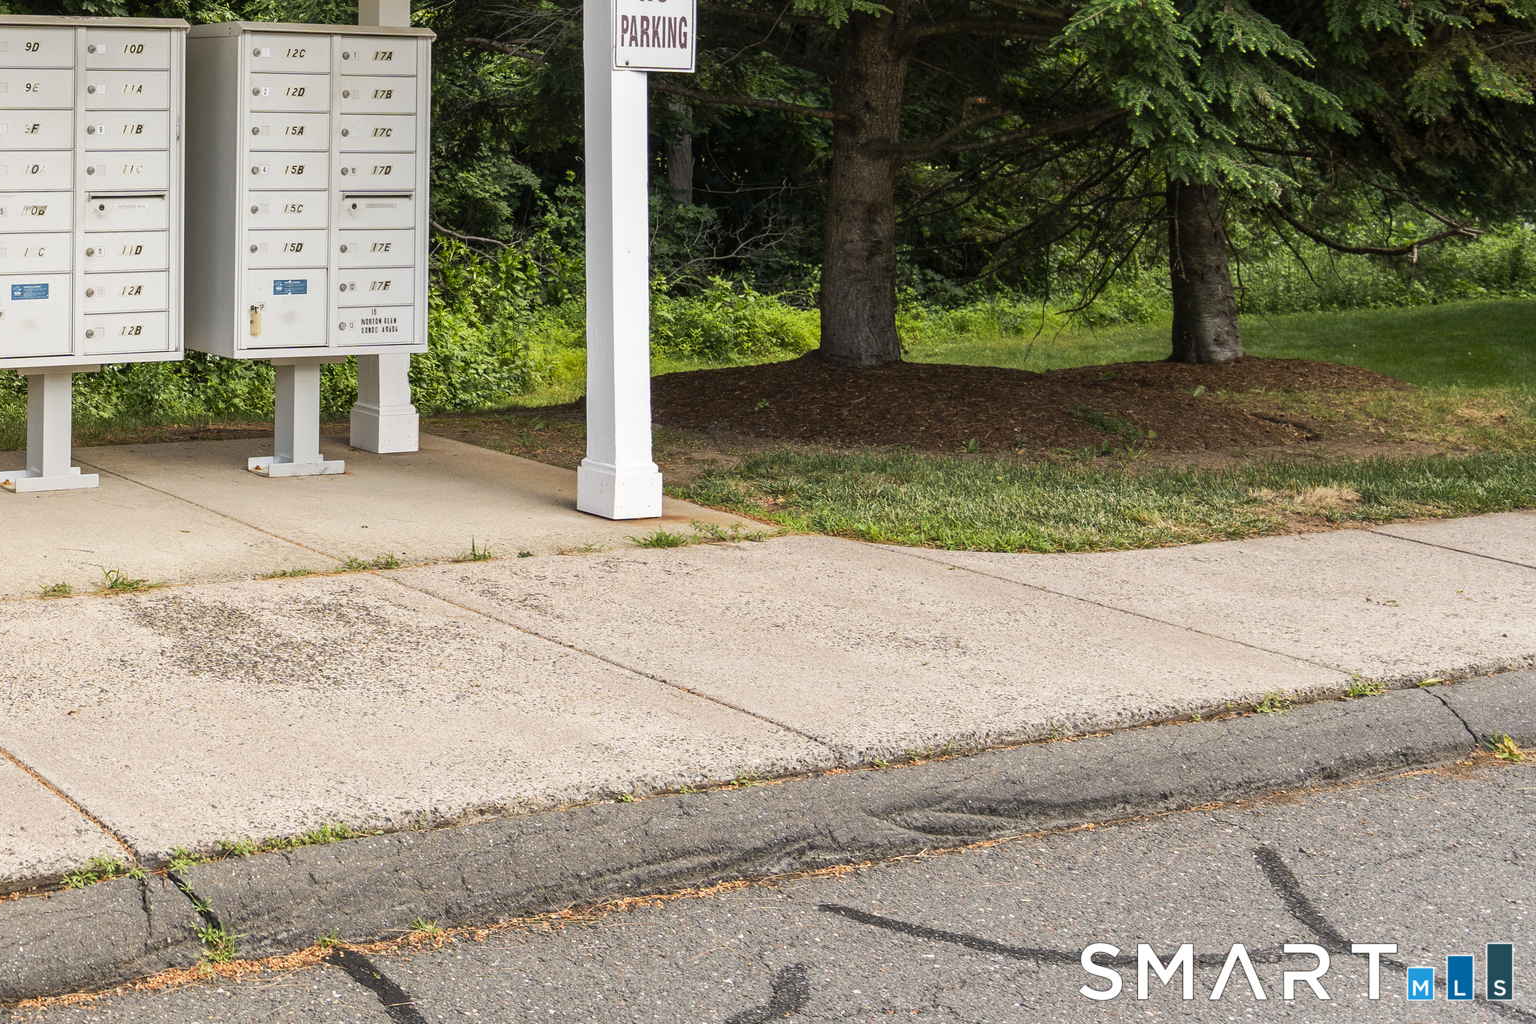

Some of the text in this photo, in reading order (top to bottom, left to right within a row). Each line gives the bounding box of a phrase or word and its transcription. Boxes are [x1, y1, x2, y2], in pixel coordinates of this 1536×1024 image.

[621, 15, 688, 49] PARKING
[25, 43, 40, 52] 9D
[124, 44, 144, 54] 10D
[286, 49, 306, 58] 12C
[374, 51, 393, 60] 17A
[25, 83, 40, 92] 9E
[123, 84, 143, 93] 11A
[286, 88, 305, 97] 12D
[374, 89, 392, 99] 17B
[123, 125, 143, 134] 11B
[285, 126, 305, 135] 15A
[374, 128, 392, 137] 17C
[123, 165, 142, 174] 11C
[285, 165, 305, 175] 15B
[373, 165, 392, 174] 17D
[284, 204, 303, 213] 15C
[122, 246, 142, 255] 11D
[283, 243, 303, 252] 15D
[372, 243, 391, 252] 17E
[372, 281, 391, 290] 17F
[122, 286, 142, 296] 12A
[121, 326, 142, 335] 12B
